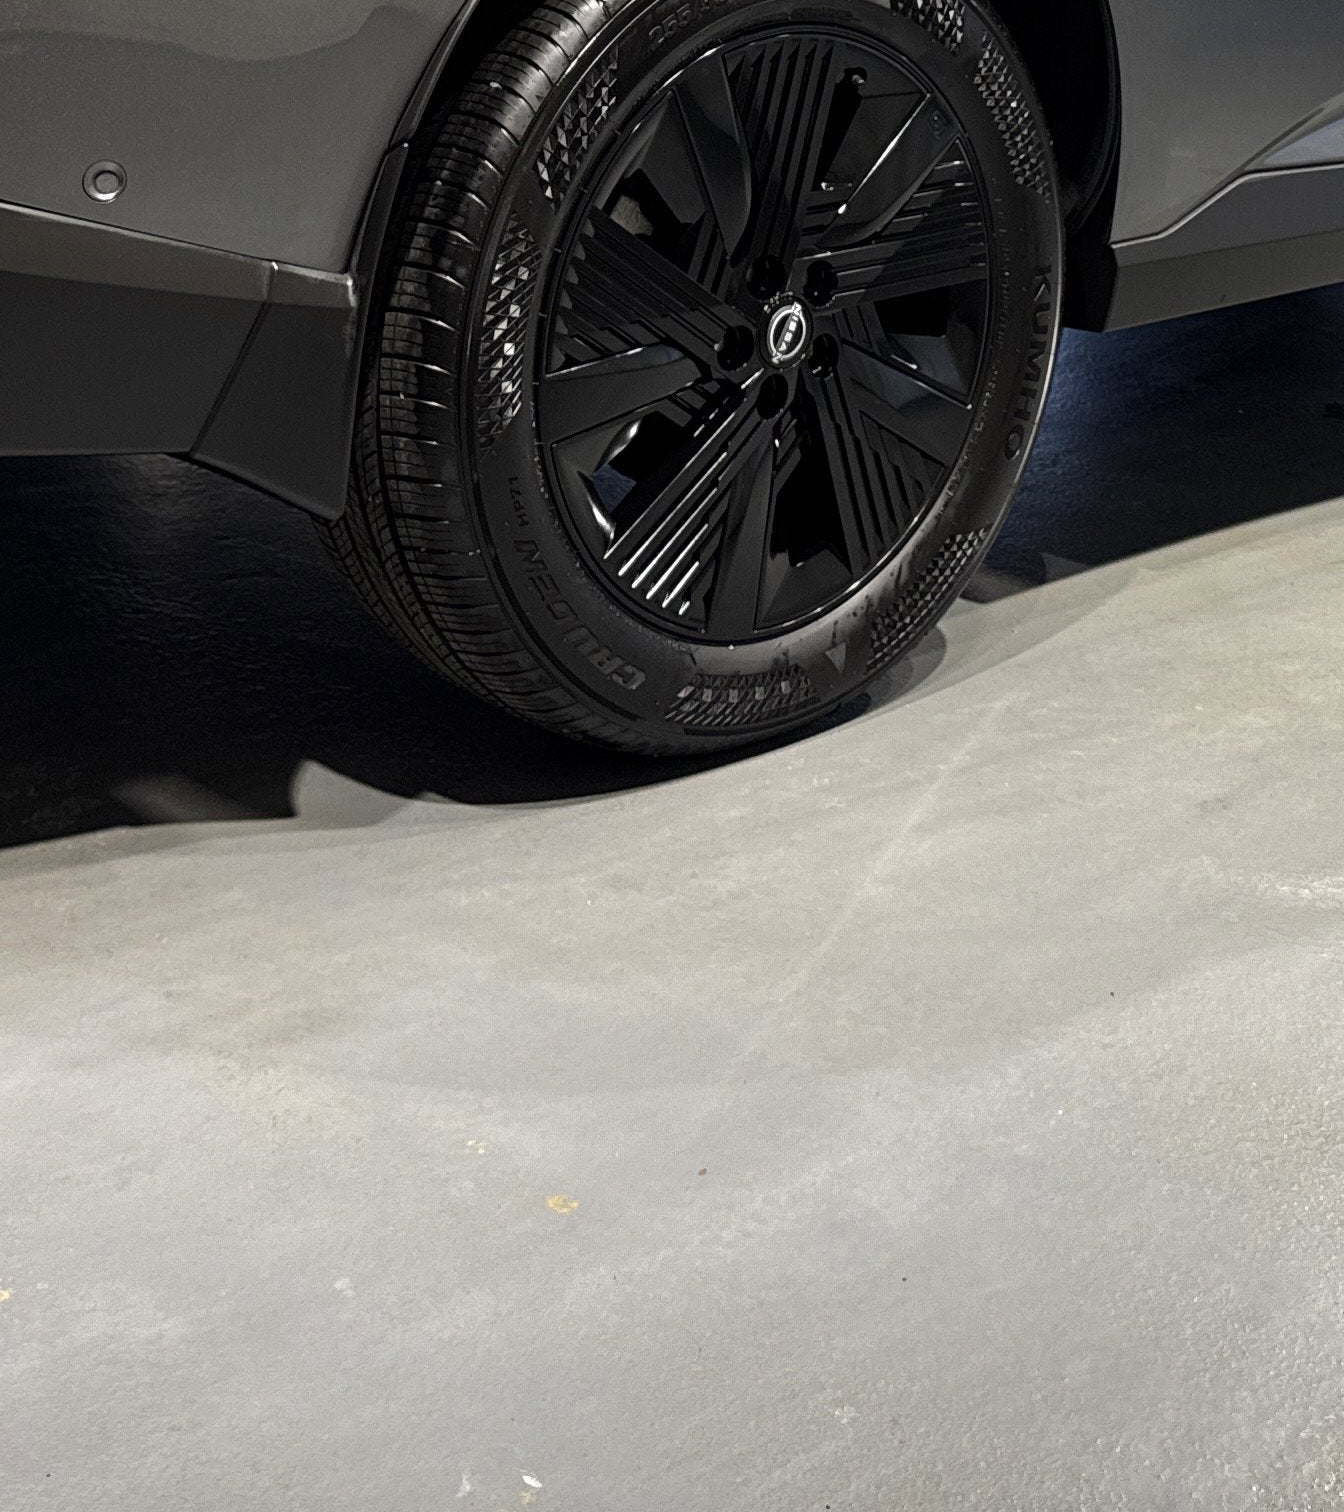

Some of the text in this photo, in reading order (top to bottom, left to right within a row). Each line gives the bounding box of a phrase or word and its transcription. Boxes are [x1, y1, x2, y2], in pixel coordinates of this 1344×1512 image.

[771, 301, 802, 364] NISSAN
[1005, 264, 1053, 461] KUMHO
[508, 476, 529, 528] HP71
